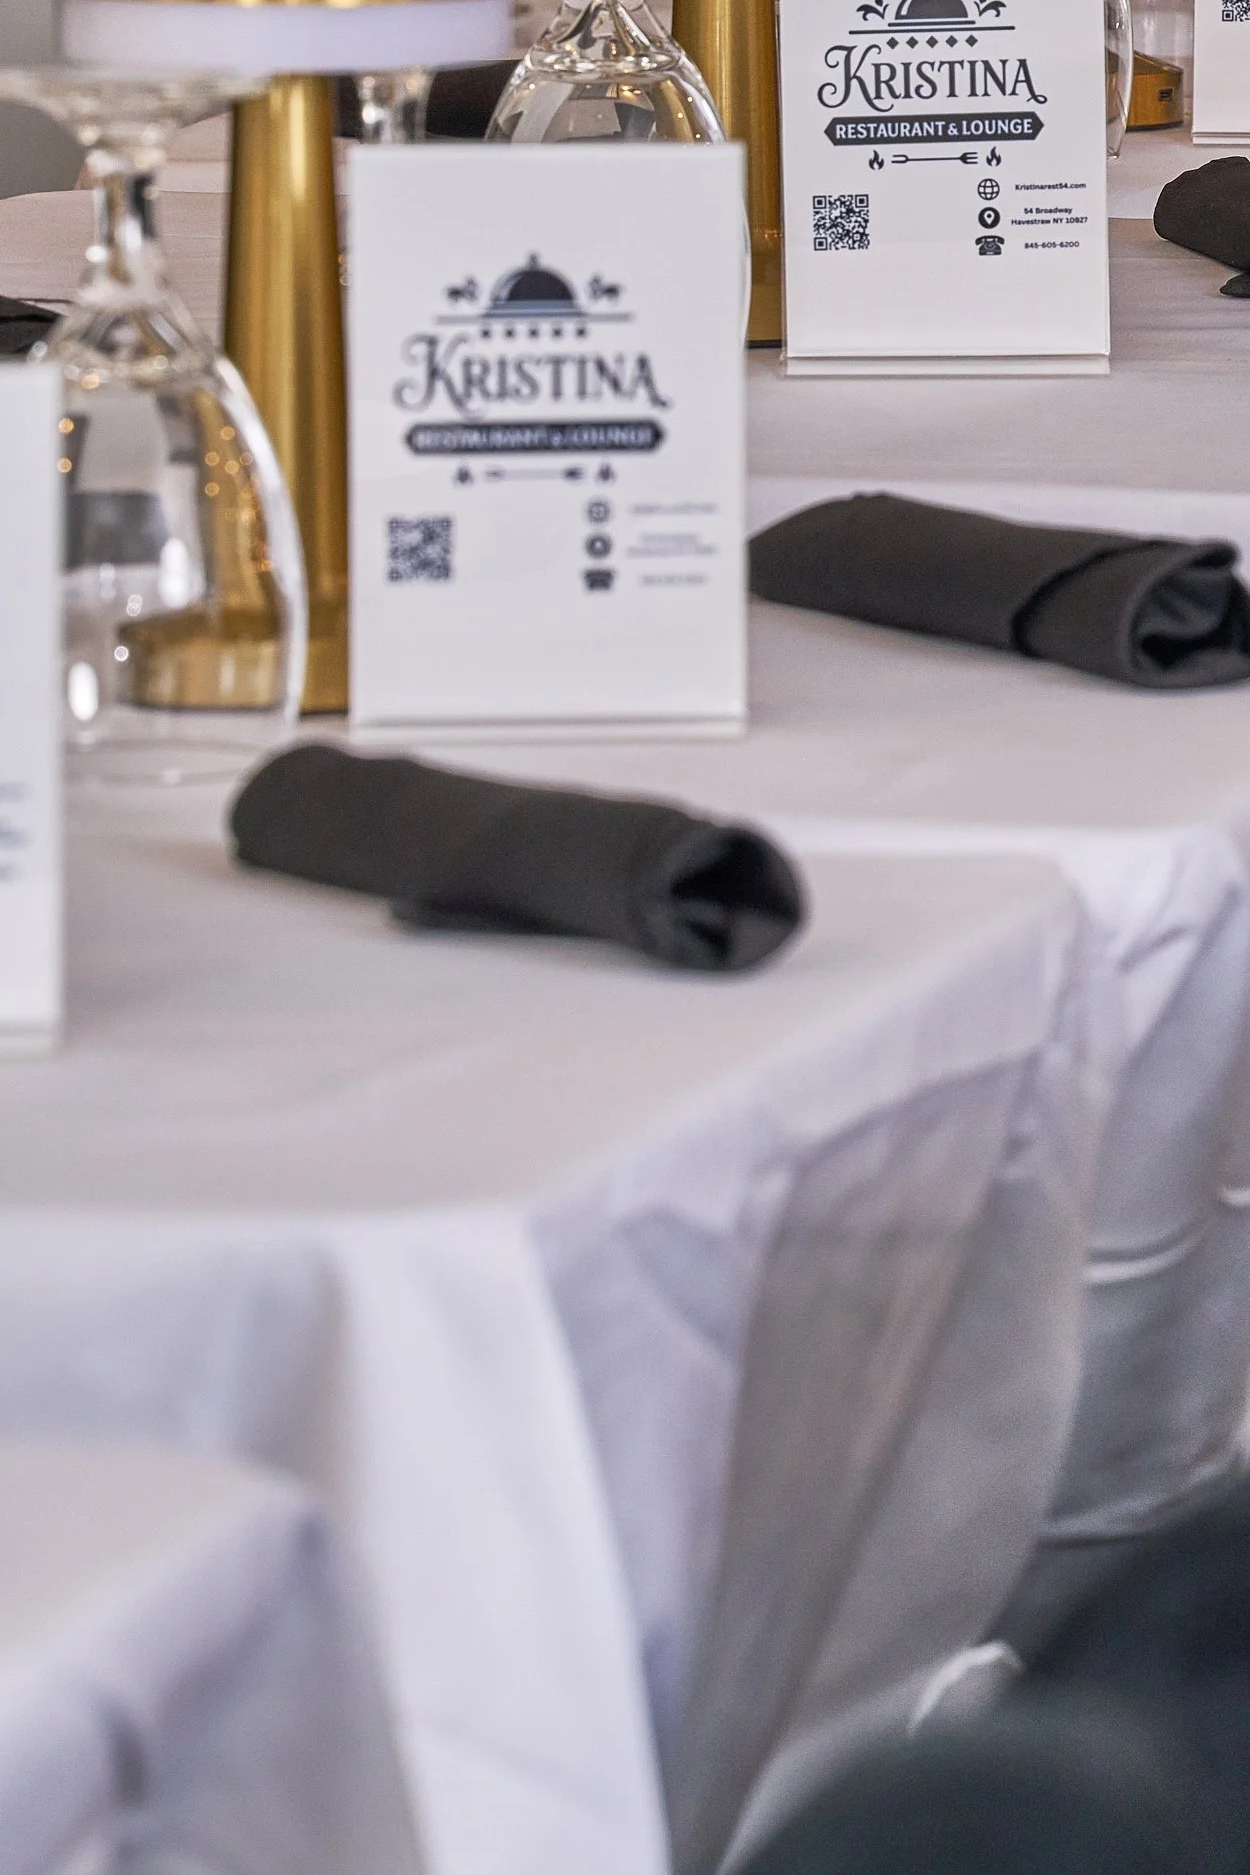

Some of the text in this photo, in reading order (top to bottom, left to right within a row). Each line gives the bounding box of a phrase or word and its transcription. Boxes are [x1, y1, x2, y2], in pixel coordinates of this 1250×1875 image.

[817, 43, 1048, 113] KRISTINA
[835, 118, 1033, 140] RESTAURANT & LOUNGE
[1015, 182, 1087, 191] Kristinarest54.com
[1035, 206, 1073, 215] Broadway
[1024, 241, 1080, 249] 845-605-6200
[392, 331, 674, 422] KRISTINA
